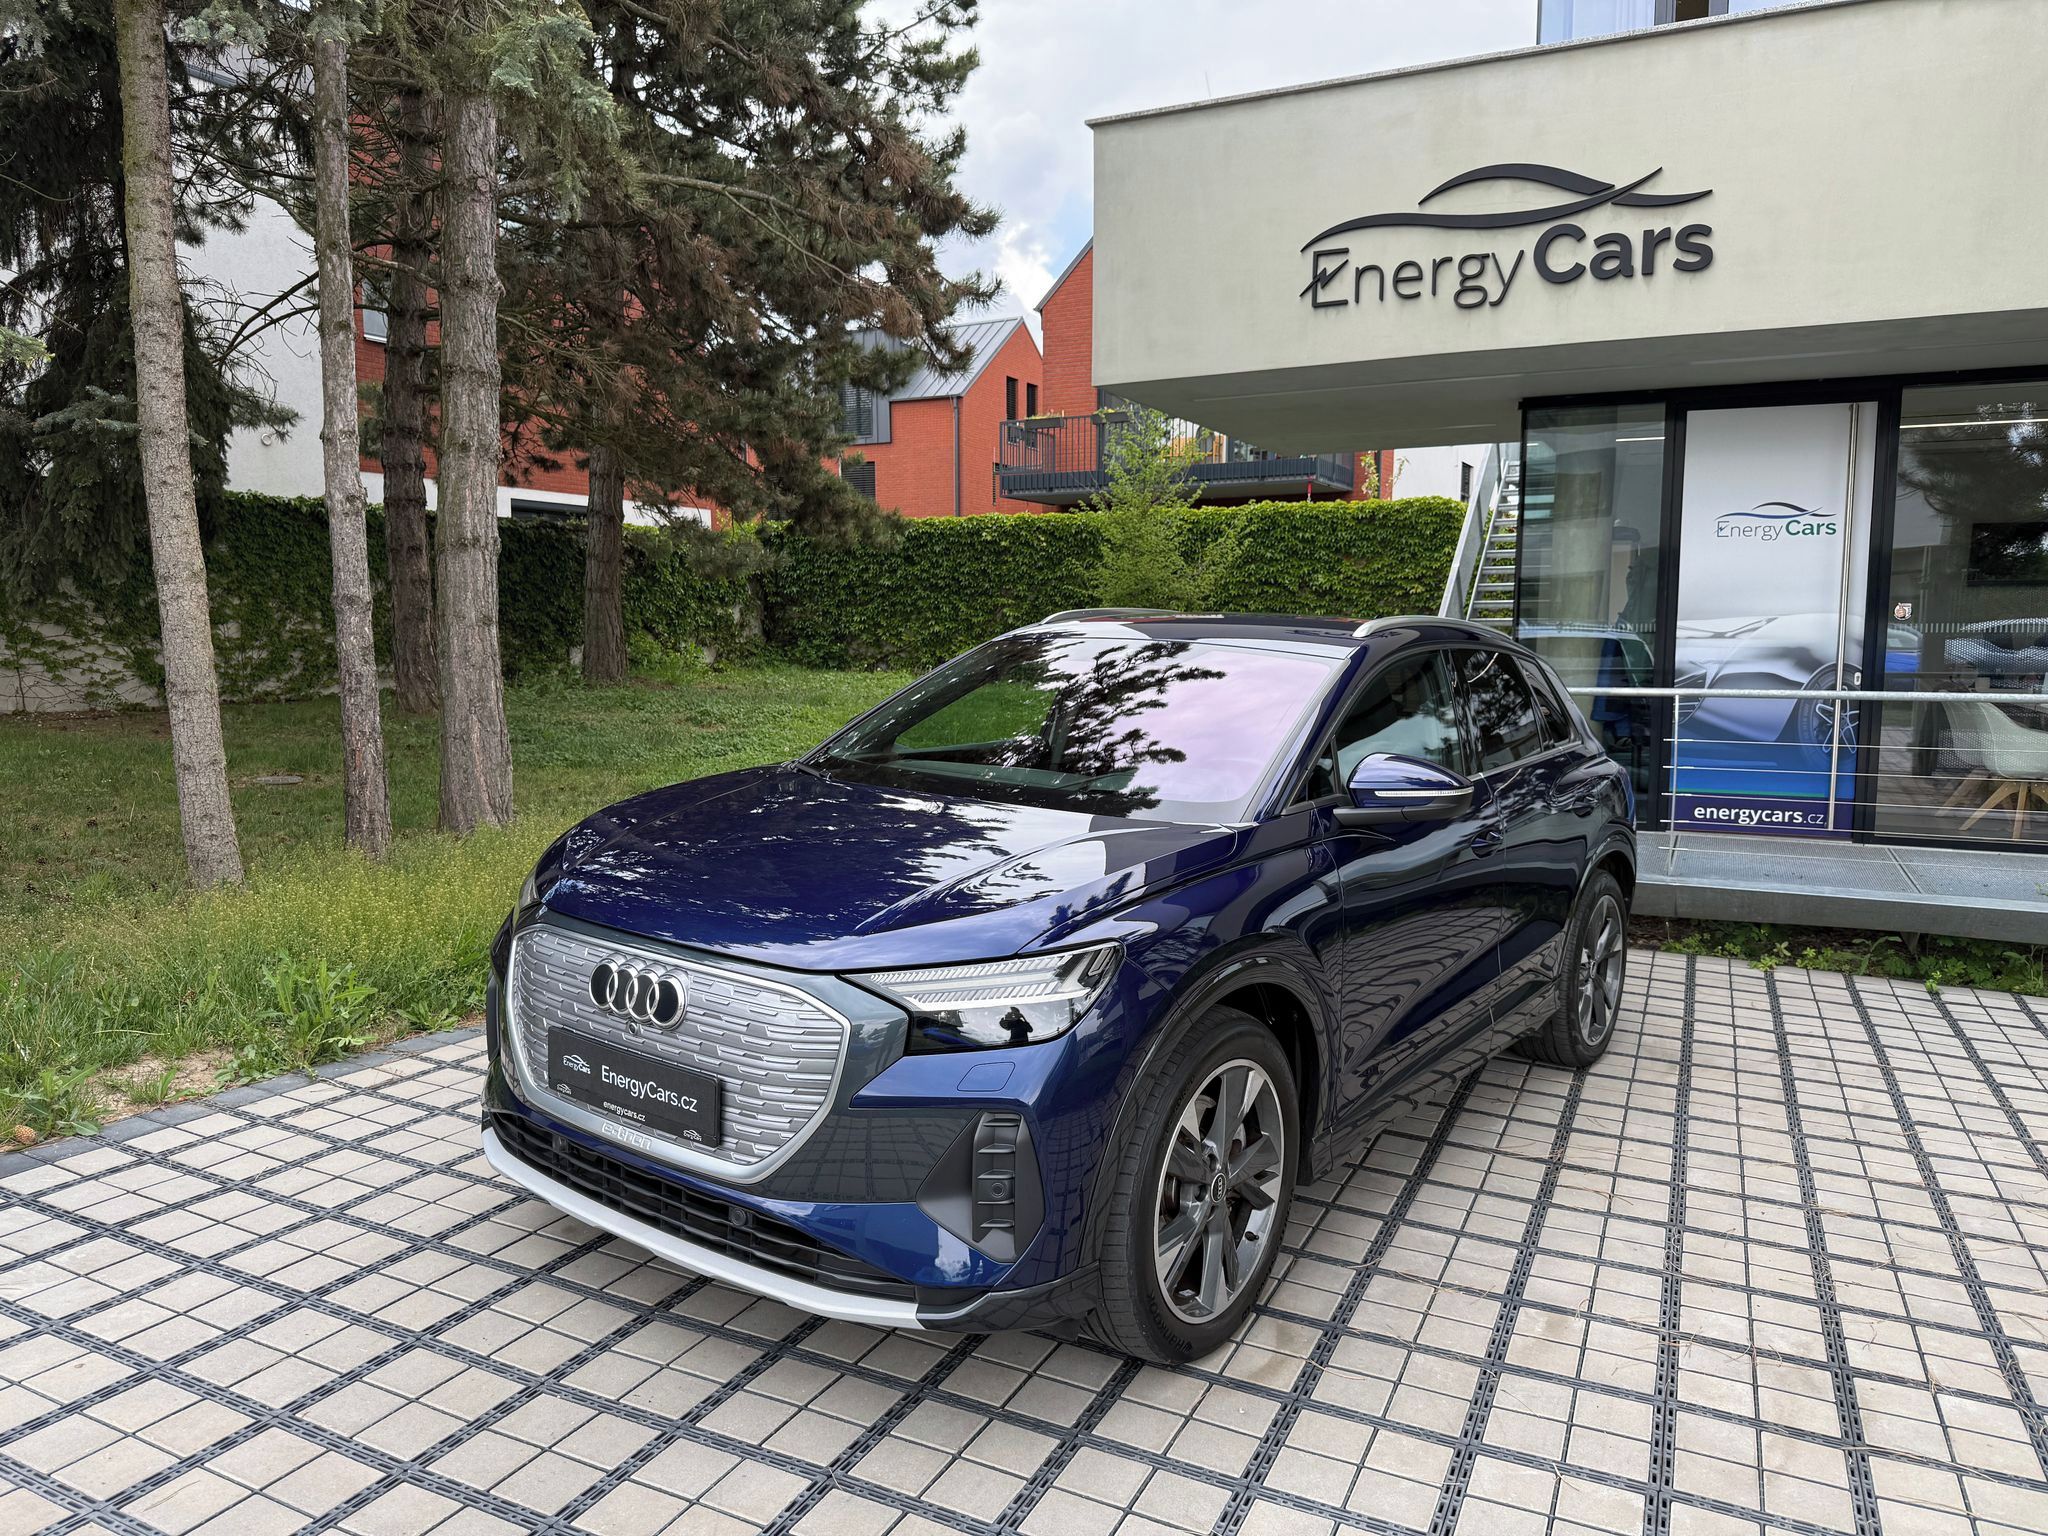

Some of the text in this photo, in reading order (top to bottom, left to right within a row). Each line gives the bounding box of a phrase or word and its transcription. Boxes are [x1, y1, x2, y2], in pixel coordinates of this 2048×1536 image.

[1301, 223, 1714, 309] EnergyCars
[1715, 519, 1837, 542] EnergyCars
[1693, 806, 1824, 825] energycars.cz
[601, 1064, 698, 1112] EnergyCars.cz
[603, 1100, 646, 1122] energycars.cz
